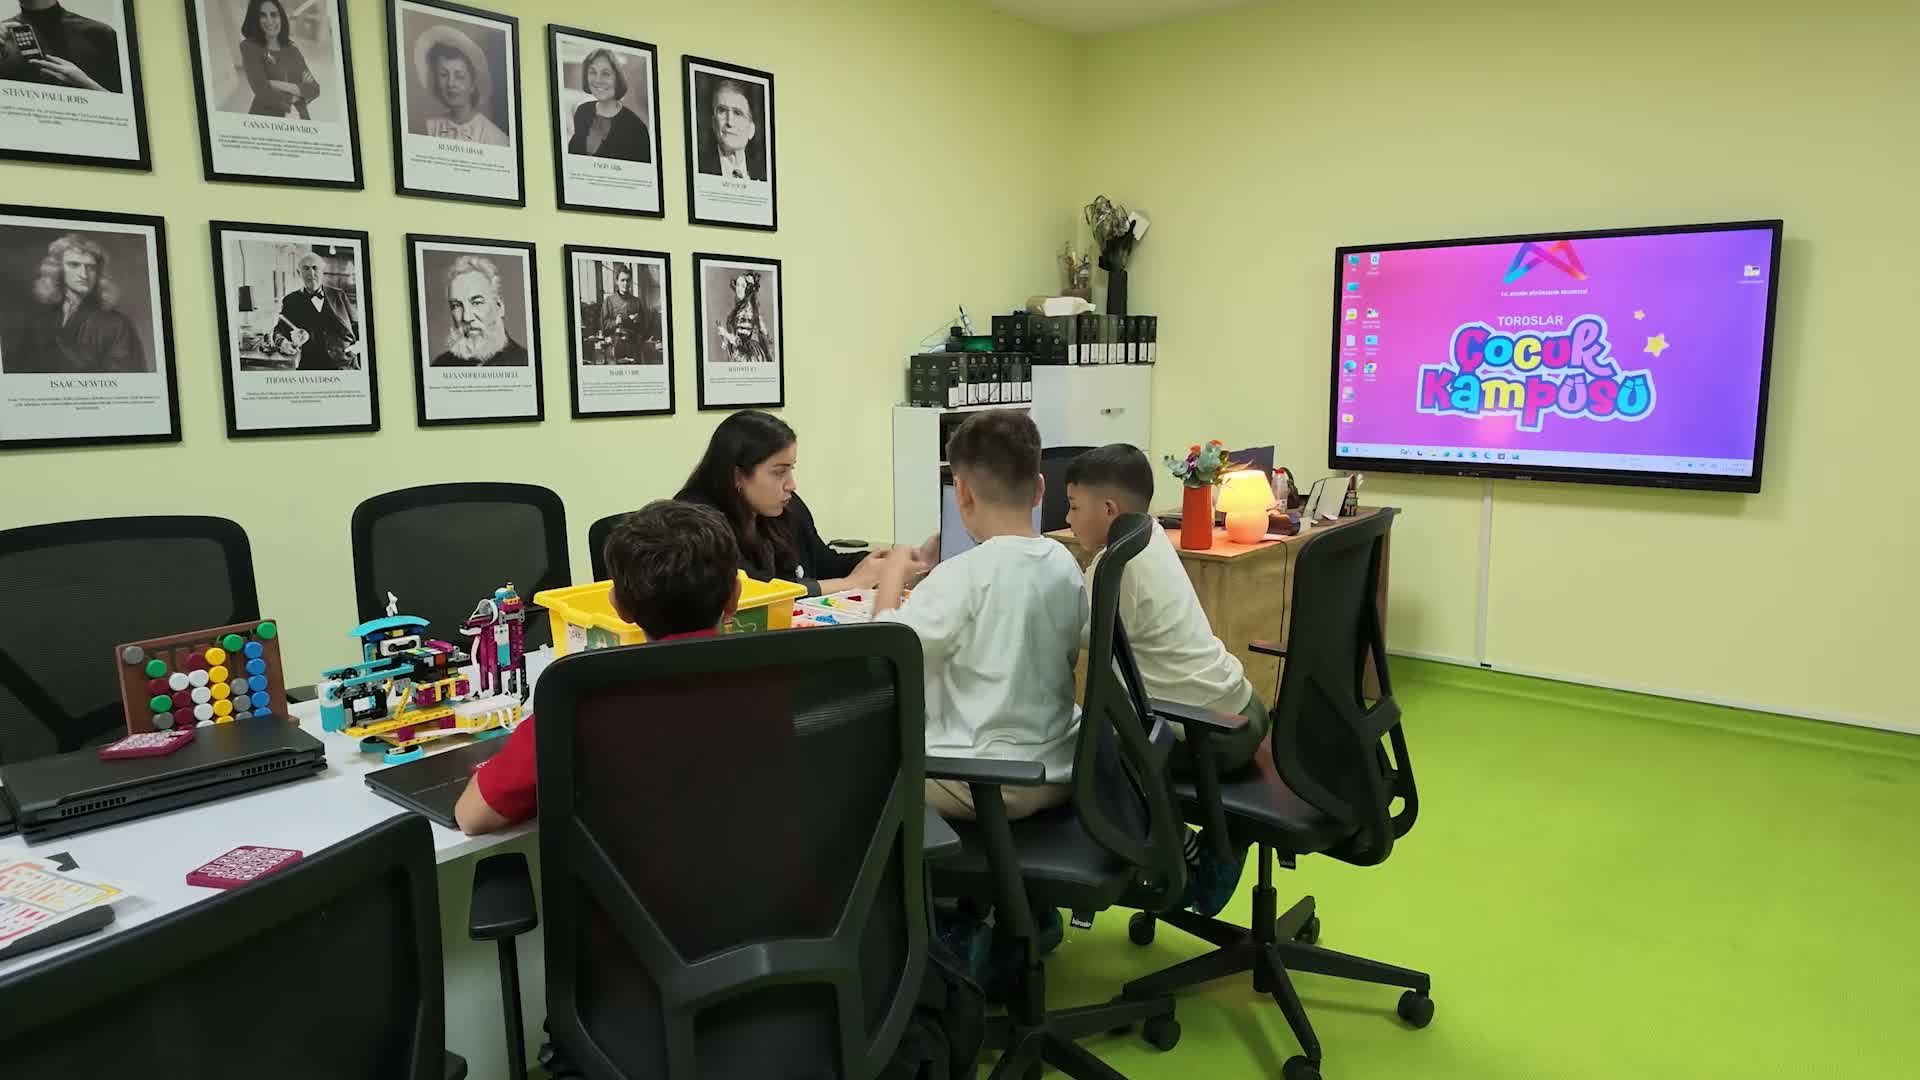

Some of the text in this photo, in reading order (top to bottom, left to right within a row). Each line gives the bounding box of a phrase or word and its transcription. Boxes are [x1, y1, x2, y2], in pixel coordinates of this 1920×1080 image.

[1497, 315, 1564, 326] TOROSLAR
[50, 379, 119, 389] ISAAC NEWTON
[266, 376, 297, 385] THOMAS
